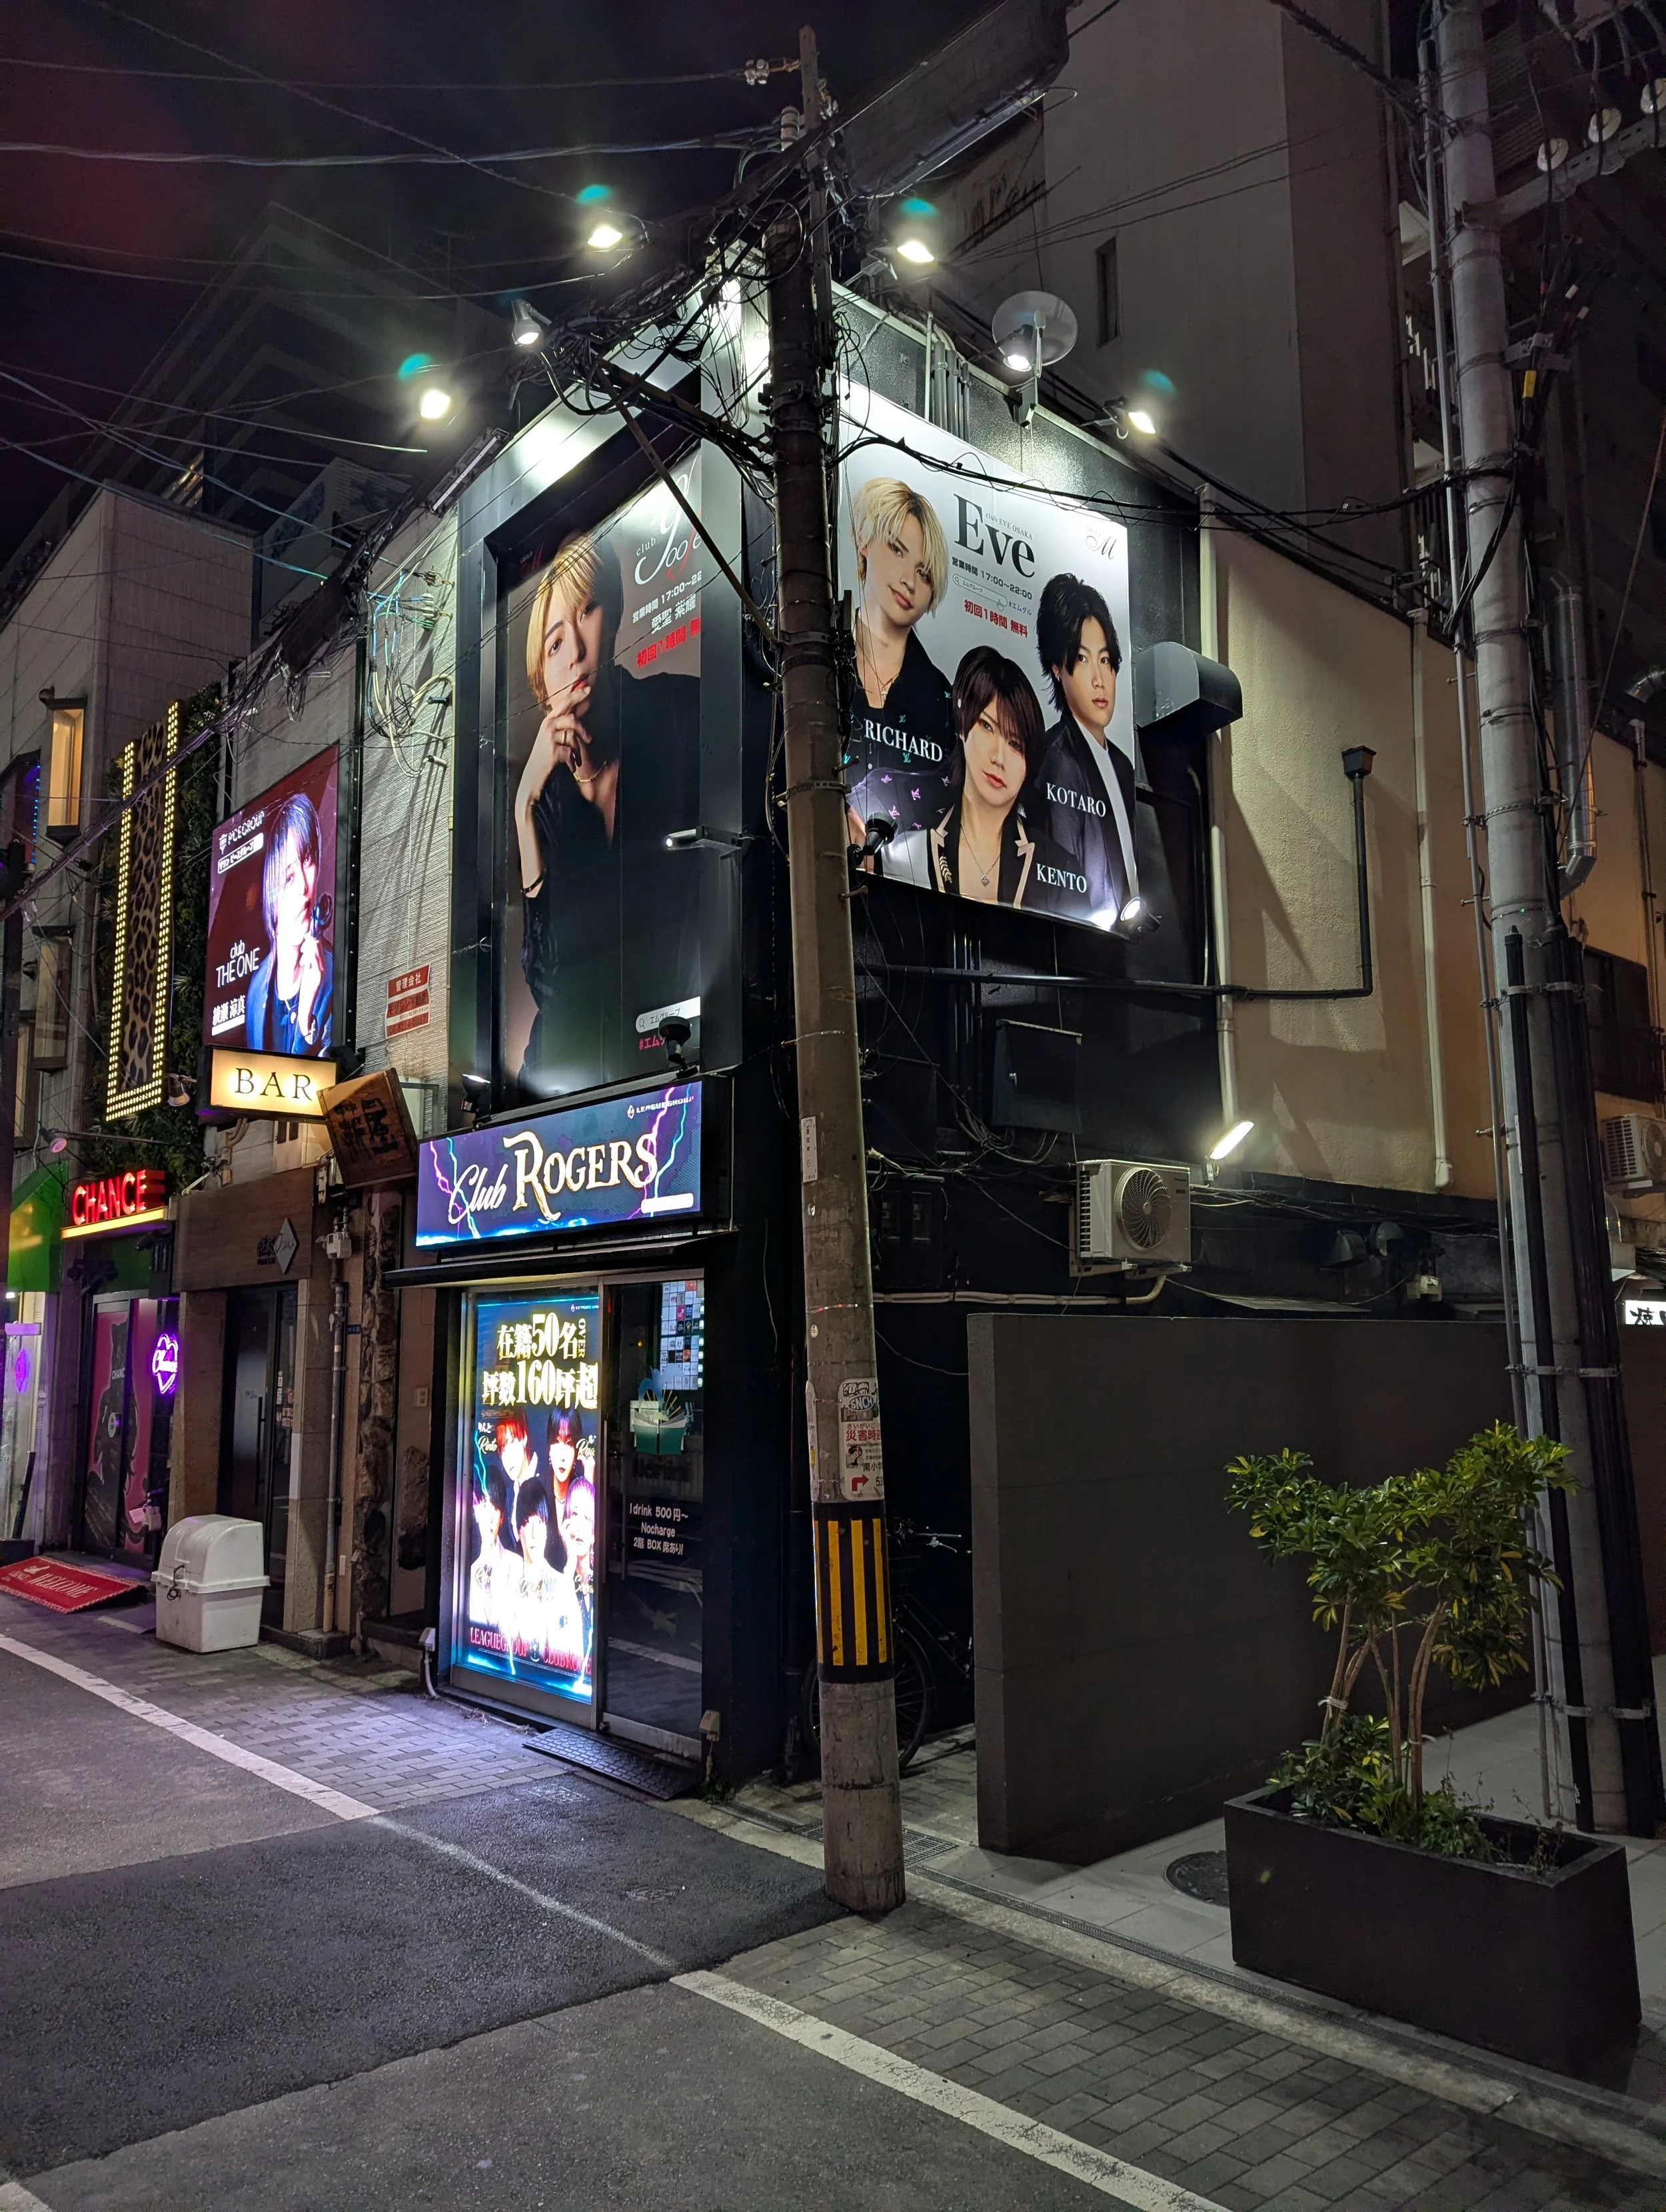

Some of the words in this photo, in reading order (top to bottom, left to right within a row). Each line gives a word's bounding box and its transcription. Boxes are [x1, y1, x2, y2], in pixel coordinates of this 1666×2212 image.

[953, 492, 1035, 578] Eve
[985, 512, 998, 523] club
[999, 518, 1012, 530] EVE
[1012, 524, 1033, 540] OSAKA
[636, 537, 656, 556] club
[952, 556, 978, 576] 営業時間
[962, 580, 984, 594] エムグループ
[632, 598, 658, 624] 営業時間
[1010, 619, 1028, 638] 無料
[865, 719, 944, 763] RICHARD
[1046, 782, 1108, 818] KOTARO
[1035, 862, 1088, 893] KENTO
[230, 939, 245, 959] club
[215, 959, 236, 988] THE
[236, 947, 261, 978] ONE
[395, 971, 421, 993] 管理会社
[234, 1067, 313, 1101] BAR
[72, 1169, 147, 1226] CHANCE
[448, 1163, 508, 1225] Club
[1629, 1307, 1666, 1325] 焼
[578, 1317, 586, 1359] OVER
[846, 1429, 881, 1442] 災害時
[640, 1521, 676, 1538] Nocharge
[633, 1536, 644, 1549] 2階
[28, 1573, 99, 1598] WELCOME
